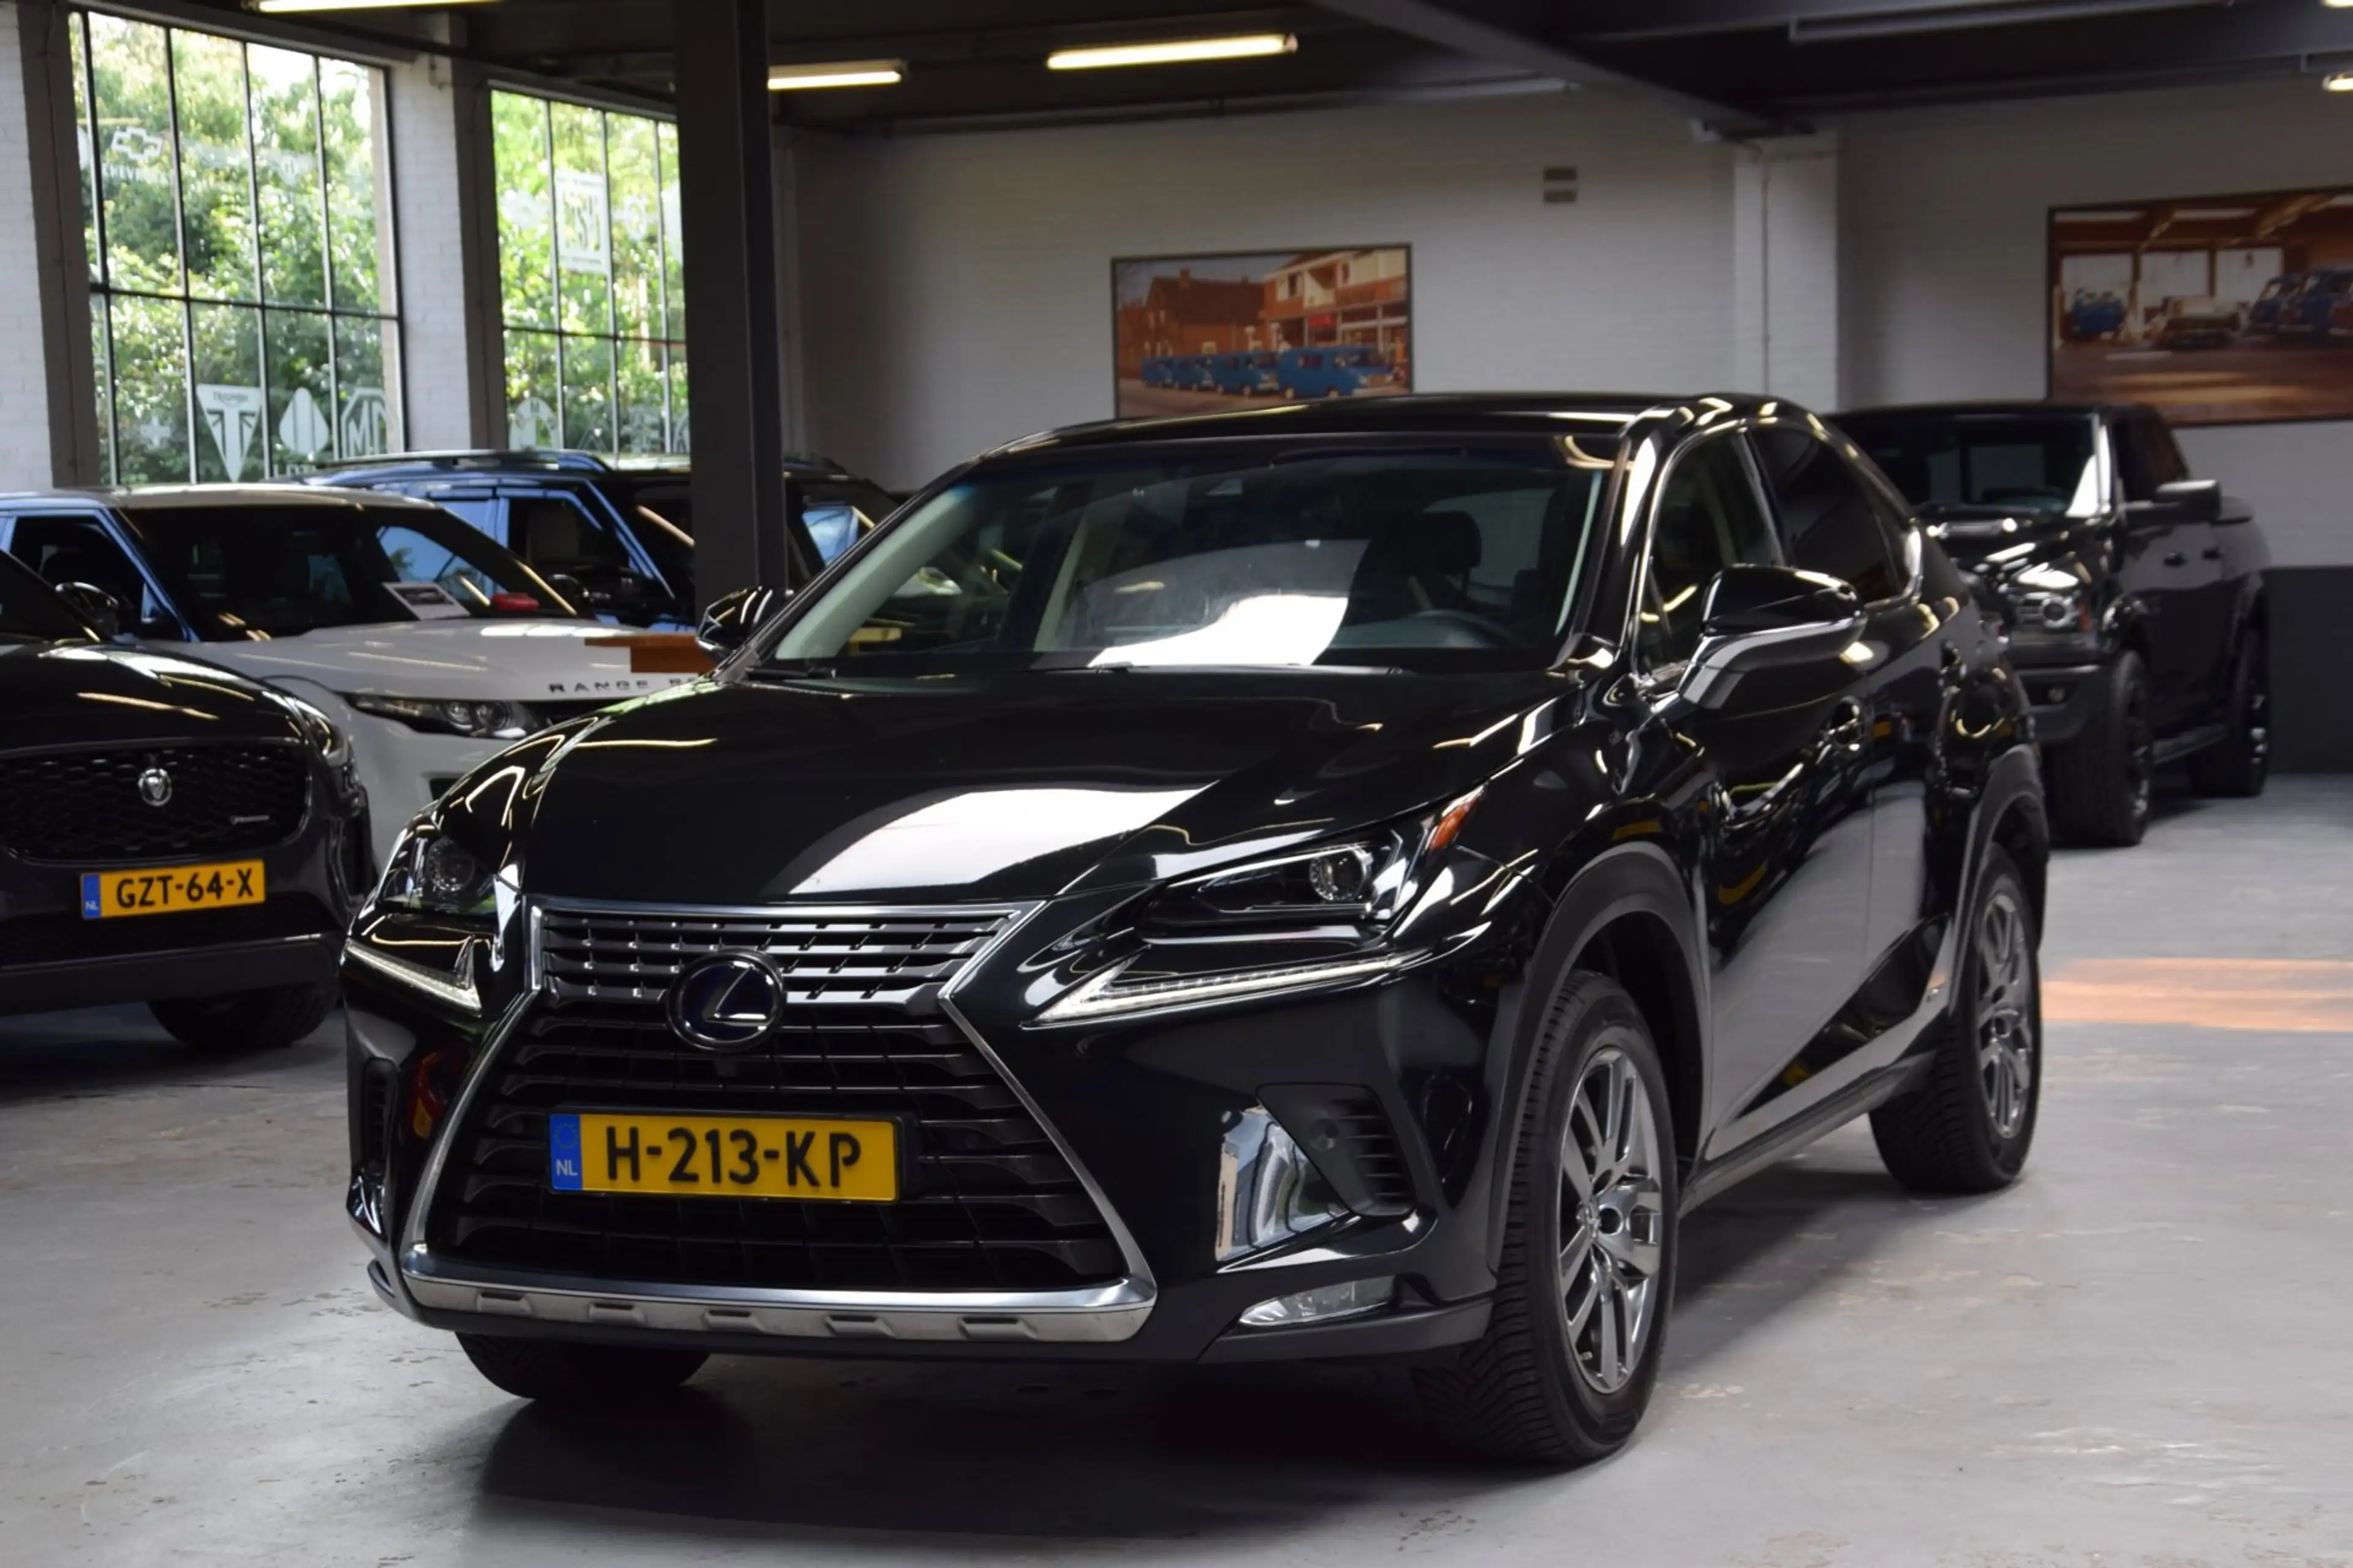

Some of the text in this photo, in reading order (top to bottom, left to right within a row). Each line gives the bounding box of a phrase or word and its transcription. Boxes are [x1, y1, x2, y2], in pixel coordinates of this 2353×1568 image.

[548, 680, 649, 694] RANGE
[116, 868, 254, 908] GZT-64-X
[85, 901, 99, 911] NL
[606, 1126, 862, 1187] H-213-KP
[556, 1159, 578, 1176] NL
